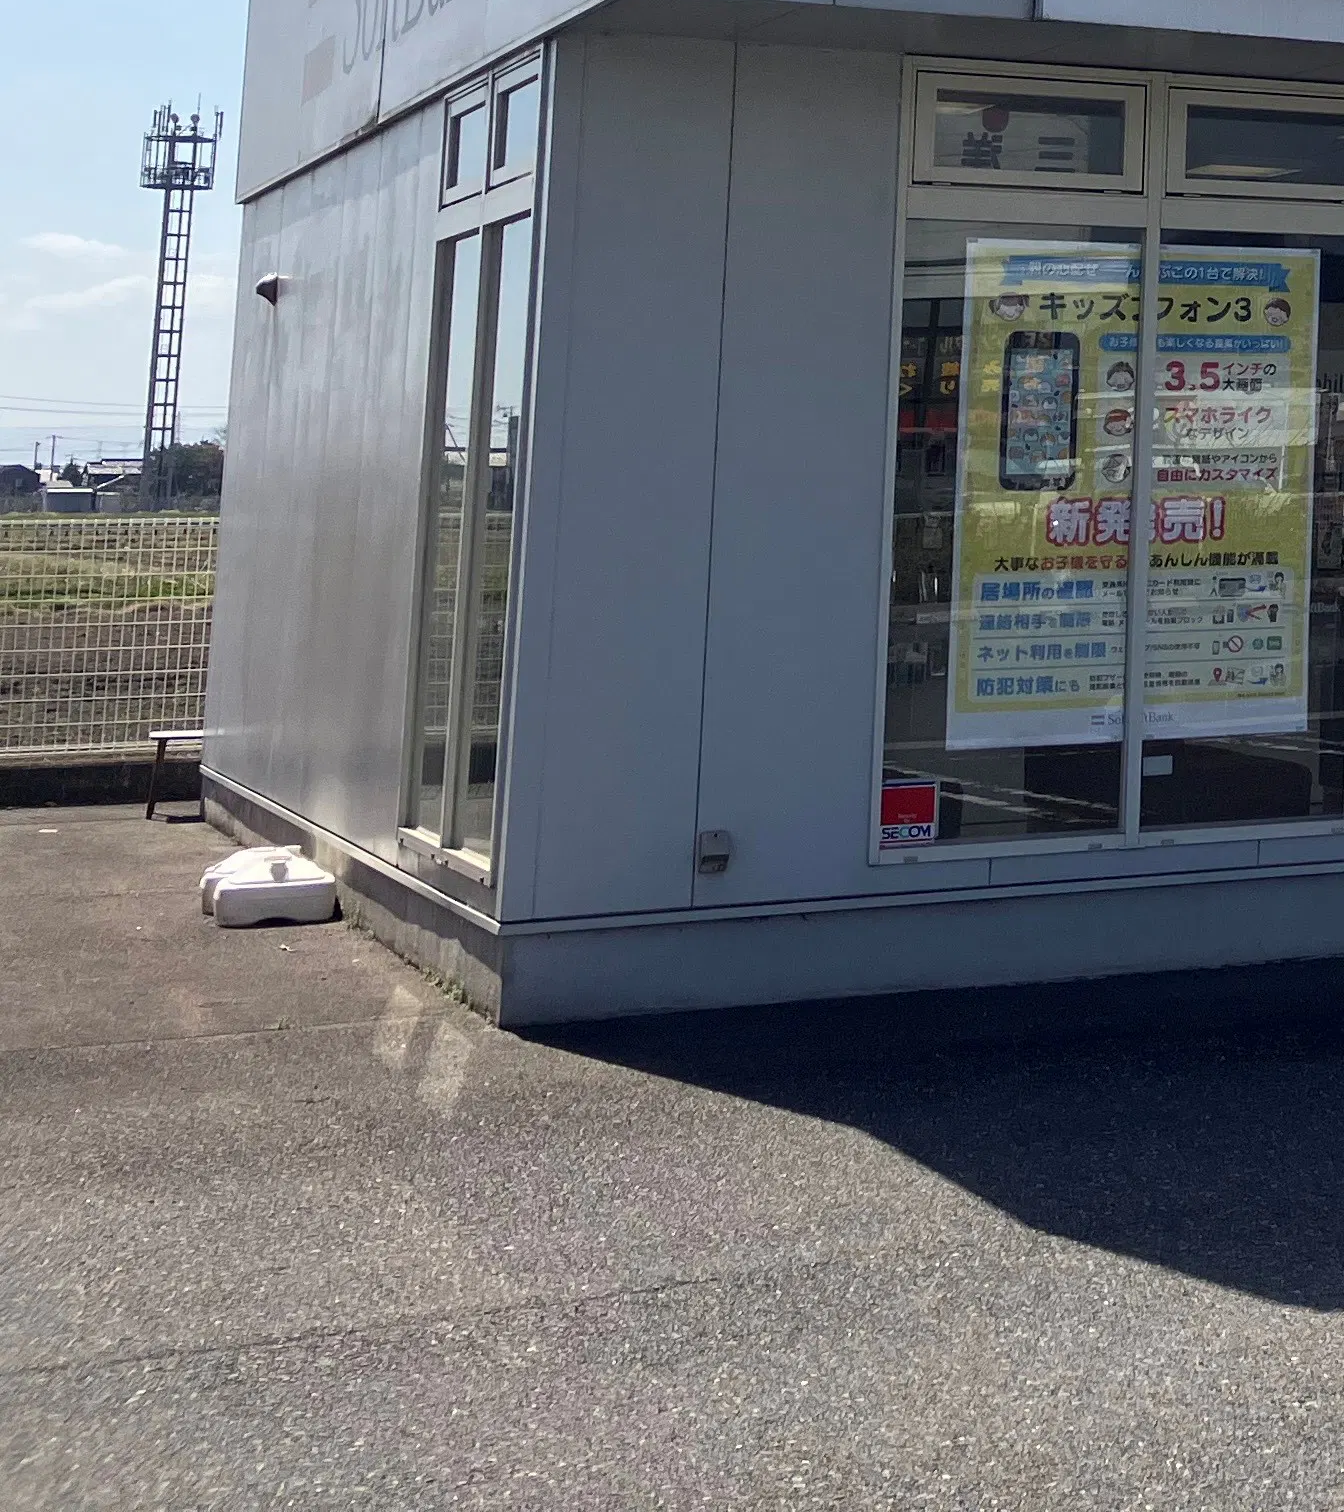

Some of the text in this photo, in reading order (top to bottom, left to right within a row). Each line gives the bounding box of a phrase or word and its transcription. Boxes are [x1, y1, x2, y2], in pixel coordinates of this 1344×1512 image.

[1039, 292, 1251, 322] キッズフォン3
[1157, 467, 1278, 482] 自由にカスタマイズ
[882, 824, 931, 839] SECOM
